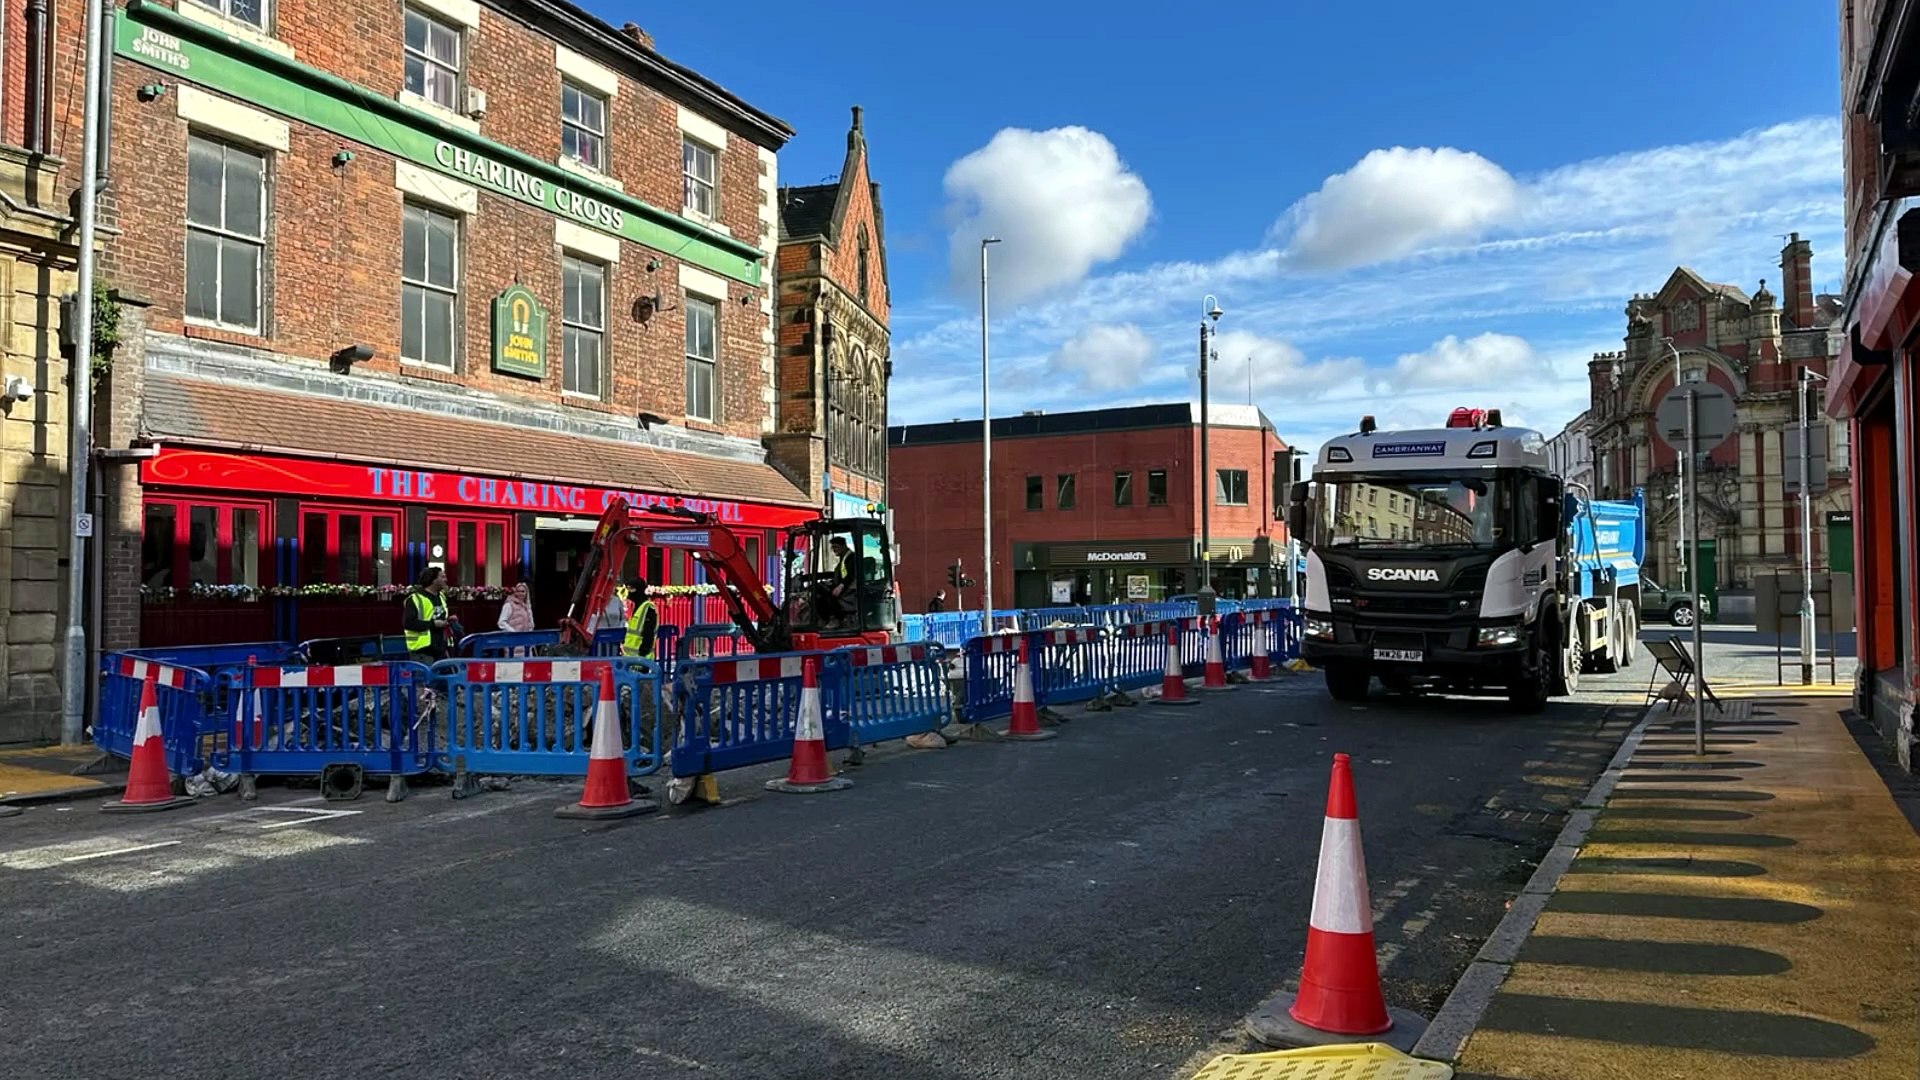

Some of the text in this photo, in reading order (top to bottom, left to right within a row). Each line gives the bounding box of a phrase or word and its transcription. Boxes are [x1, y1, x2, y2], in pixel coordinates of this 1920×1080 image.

[142, 26, 181, 51] JOHN
[132, 38, 190, 69] SMITH'S
[435, 141, 624, 231] CHARING CROSS
[367, 467, 435, 498] THE
[458, 476, 585, 510] CHARING
[1087, 551, 1147, 561] McDonald's
[1368, 568, 1440, 581] SCANIA
